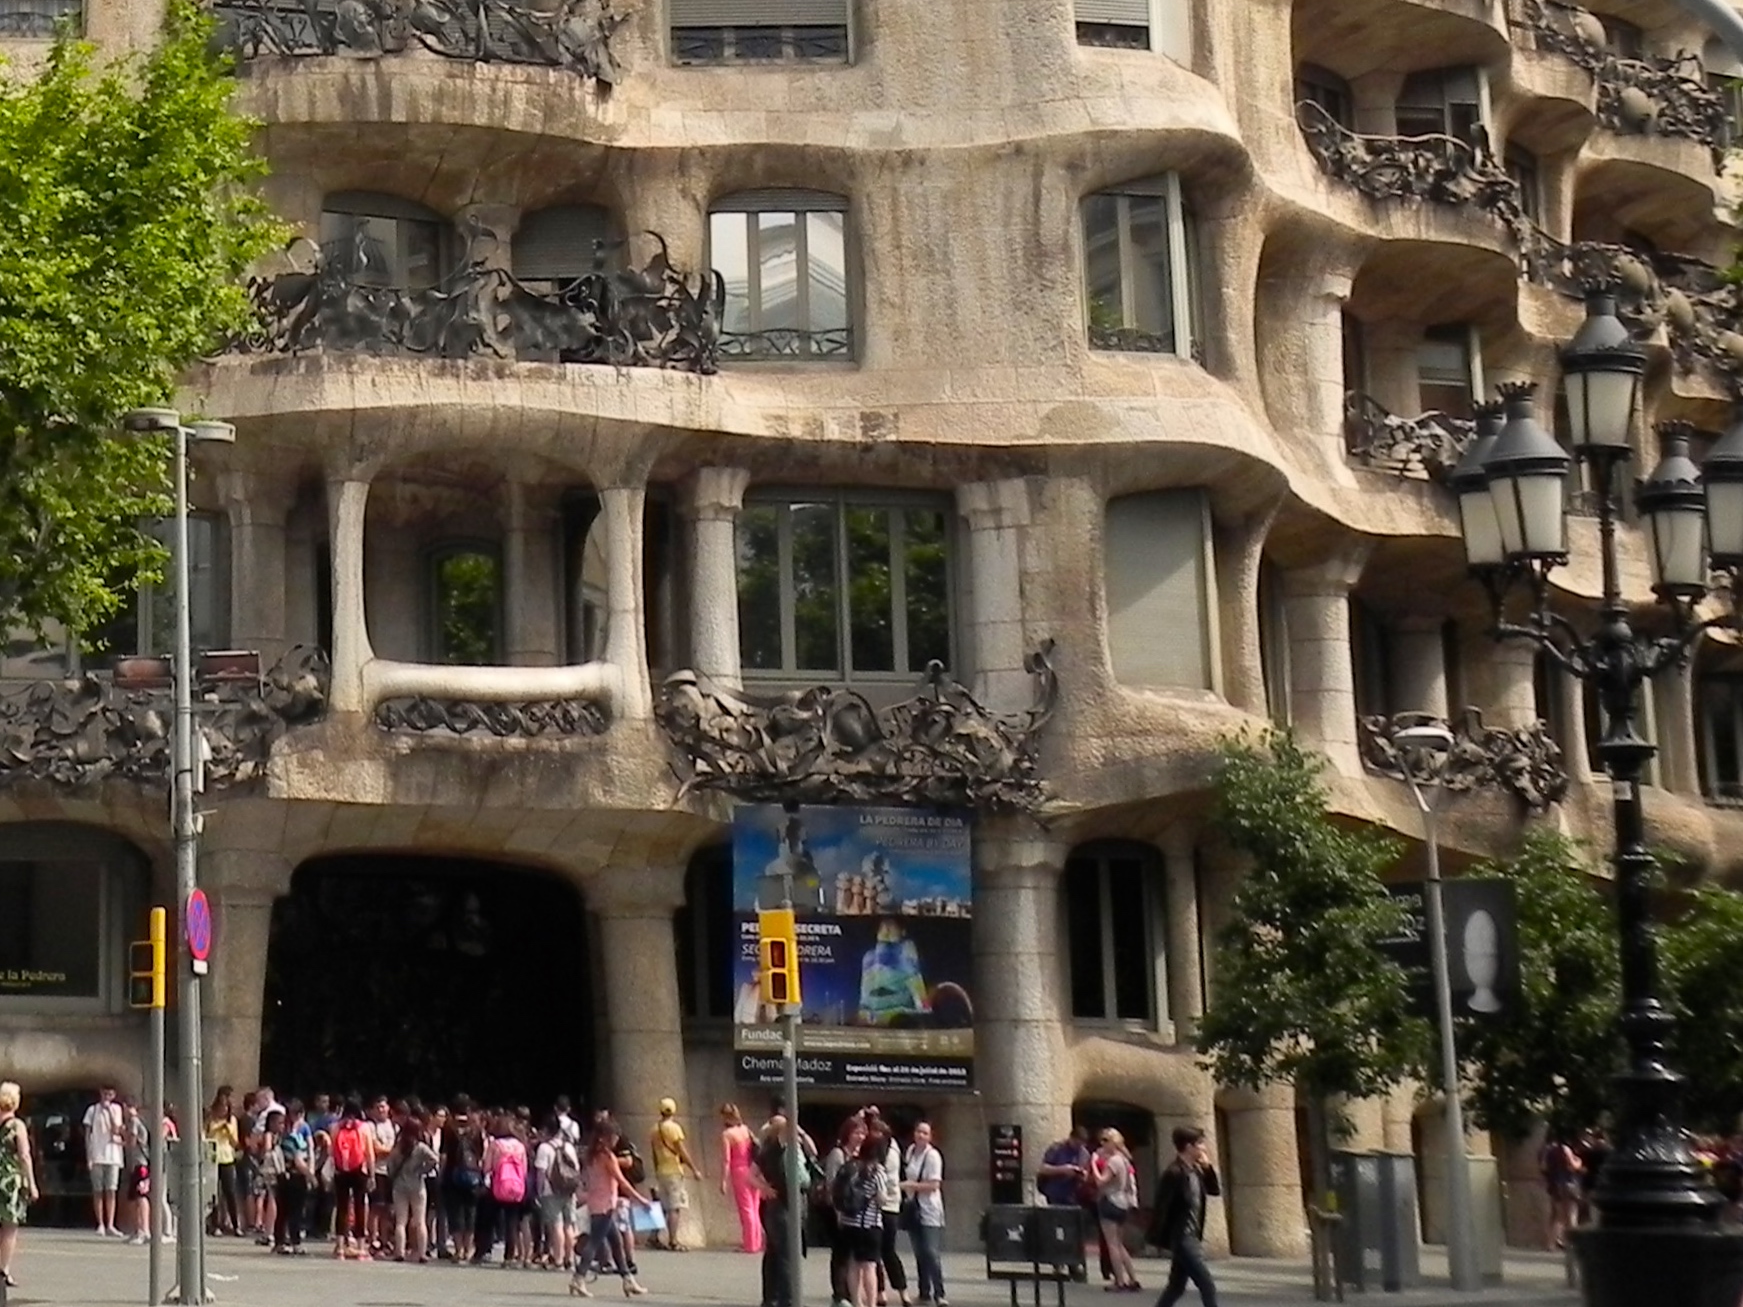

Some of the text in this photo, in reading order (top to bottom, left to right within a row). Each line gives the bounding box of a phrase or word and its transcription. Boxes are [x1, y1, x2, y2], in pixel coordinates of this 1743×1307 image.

[859, 814, 873, 824] LA
[875, 815, 926, 826] PEDRERA
[794, 923, 842, 935] SECRETA
[7, 969, 19, 980] la
[21, 969, 66, 981] Pedrera
[741, 1029, 784, 1040] Fundac
[741, 1056, 784, 1069] Chema
